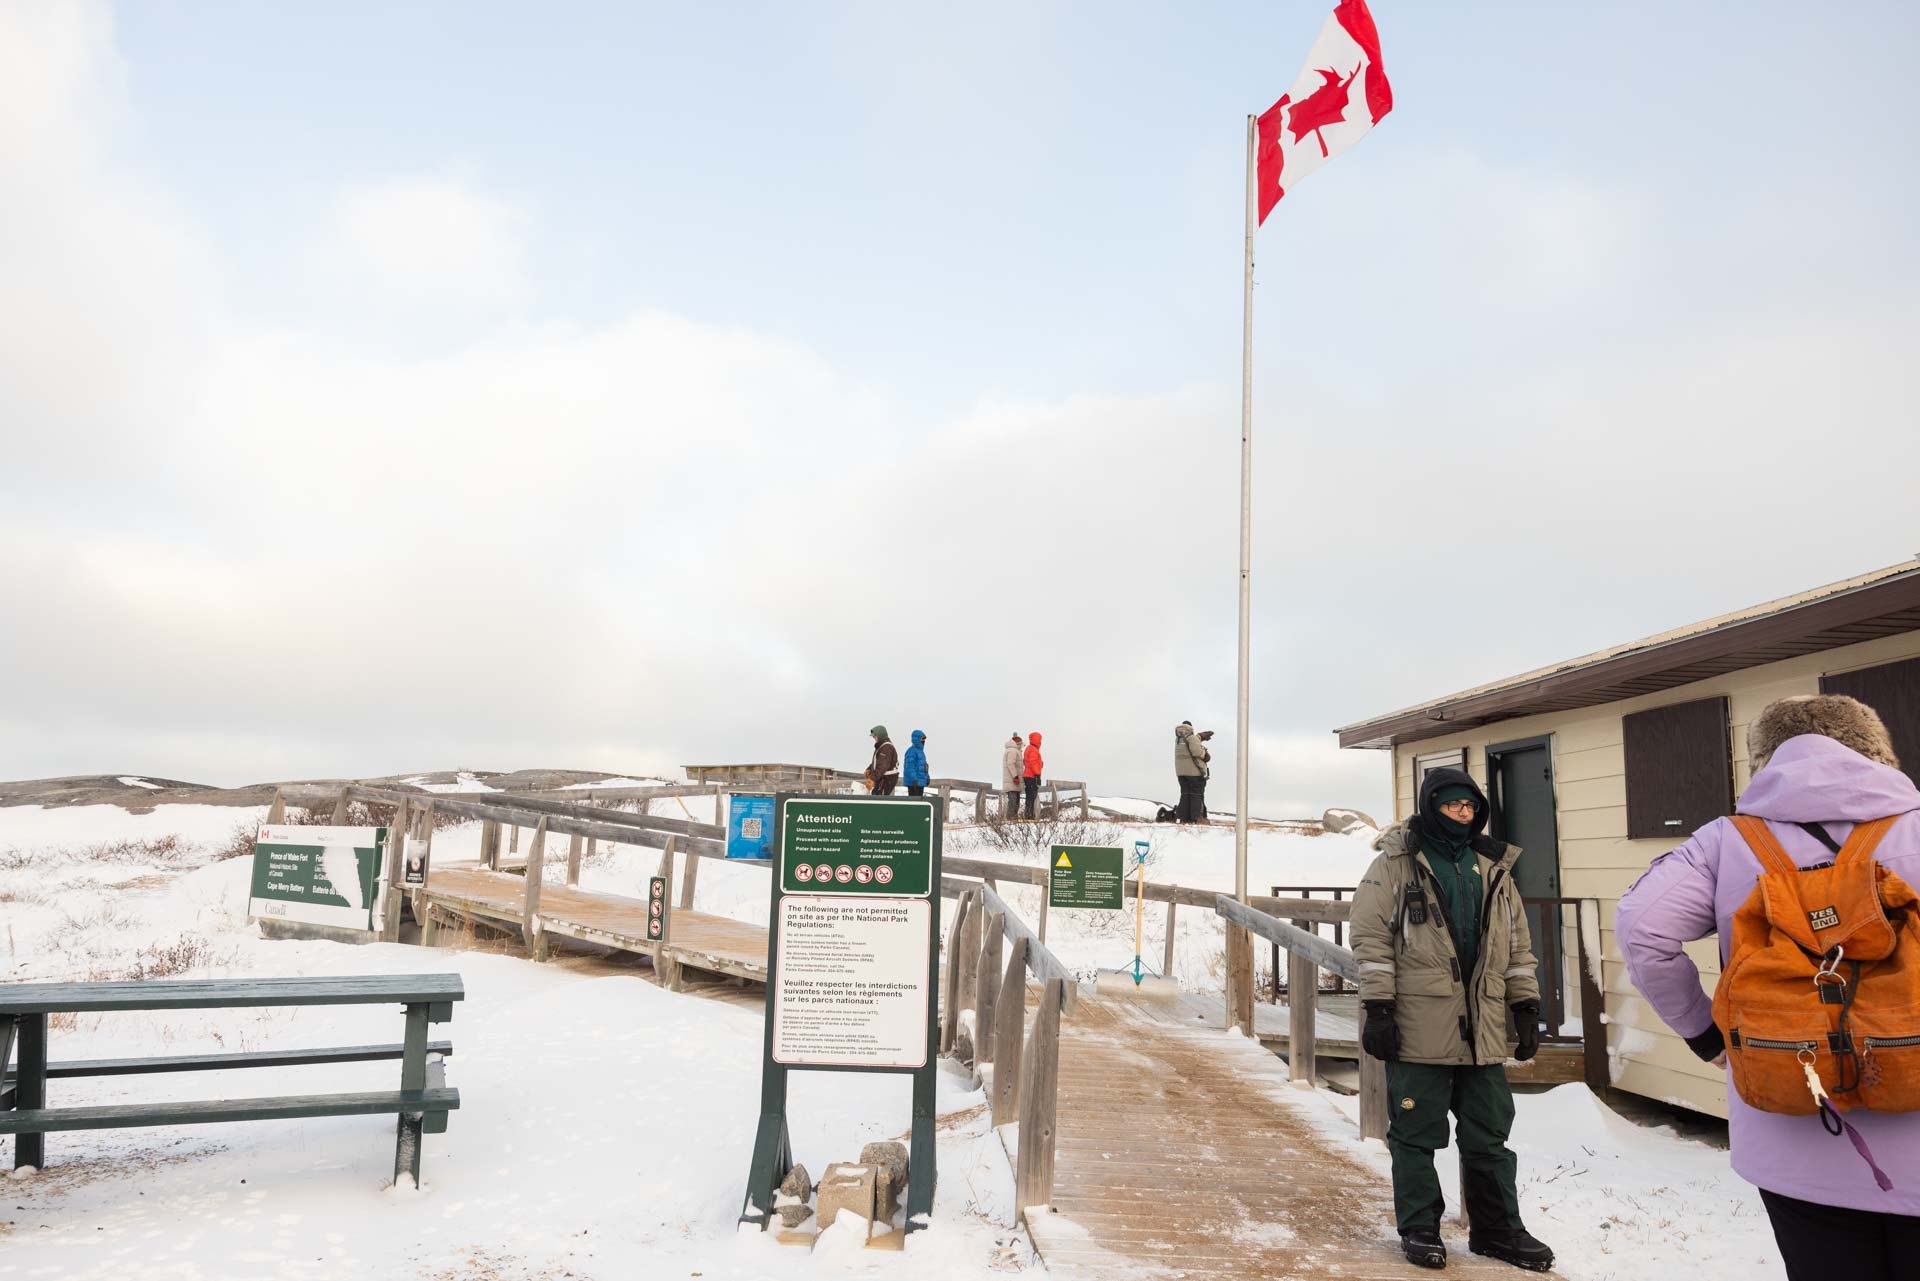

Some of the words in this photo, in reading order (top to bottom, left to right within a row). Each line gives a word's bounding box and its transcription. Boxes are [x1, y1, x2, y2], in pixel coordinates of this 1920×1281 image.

[796, 814, 852, 824] Attention!
[271, 852, 282, 861] Prince
[267, 882, 277, 892] Cape
[278, 883, 289, 893] Merry
[290, 883, 304, 894] Battery
[265, 902, 286, 916] Canada
[804, 906, 839, 914] following
[1810, 907, 1834, 919] YES
